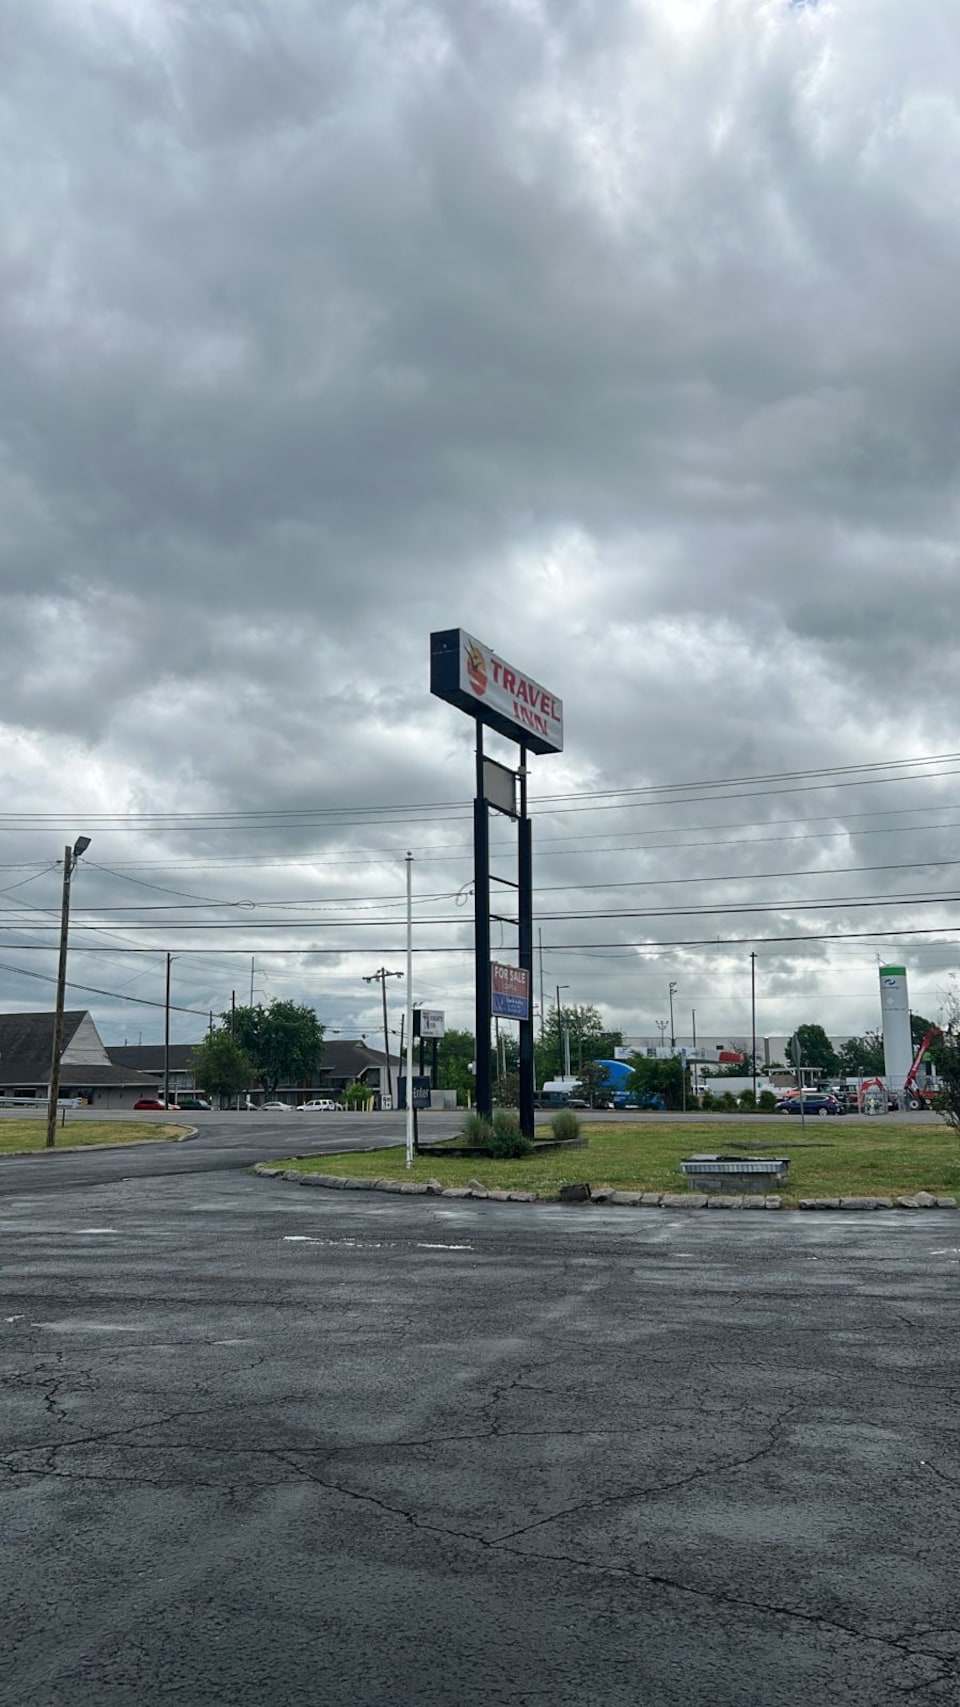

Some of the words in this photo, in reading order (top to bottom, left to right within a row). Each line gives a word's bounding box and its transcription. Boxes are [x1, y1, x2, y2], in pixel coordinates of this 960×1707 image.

[490, 658, 561, 722] TRAVEL
[513, 701, 549, 736] INN
[494, 965, 509, 980] FOR
[509, 969, 526, 984] SALE
